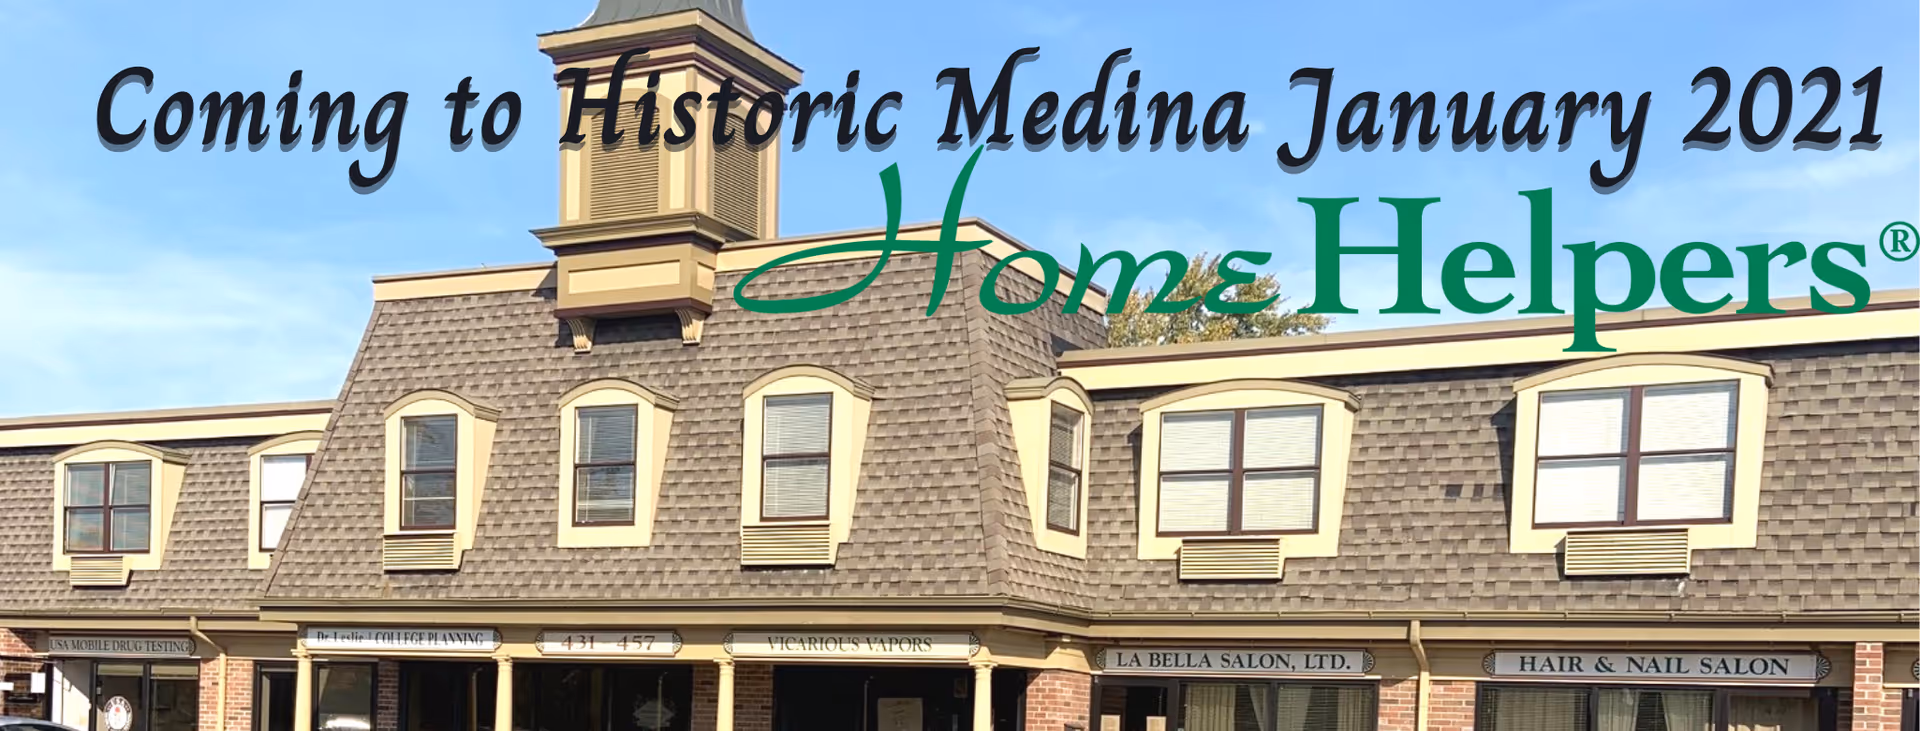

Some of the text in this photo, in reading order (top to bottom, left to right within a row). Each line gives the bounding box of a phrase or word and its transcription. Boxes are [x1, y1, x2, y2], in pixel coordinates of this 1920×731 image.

[51, 640, 188, 652] USA MOBILE DRUG TESTING
[375, 632, 425, 645] COLLEGE
[427, 633, 483, 646] PLANNING
[561, 635, 595, 650] 431
[616, 635, 656, 651] 457
[768, 637, 933, 653] VICARIOUS VAPORS
[1116, 652, 1351, 672] LA BELLA SALON, LTD.
[1519, 656, 1790, 676] HAIR & NAIL SALON
